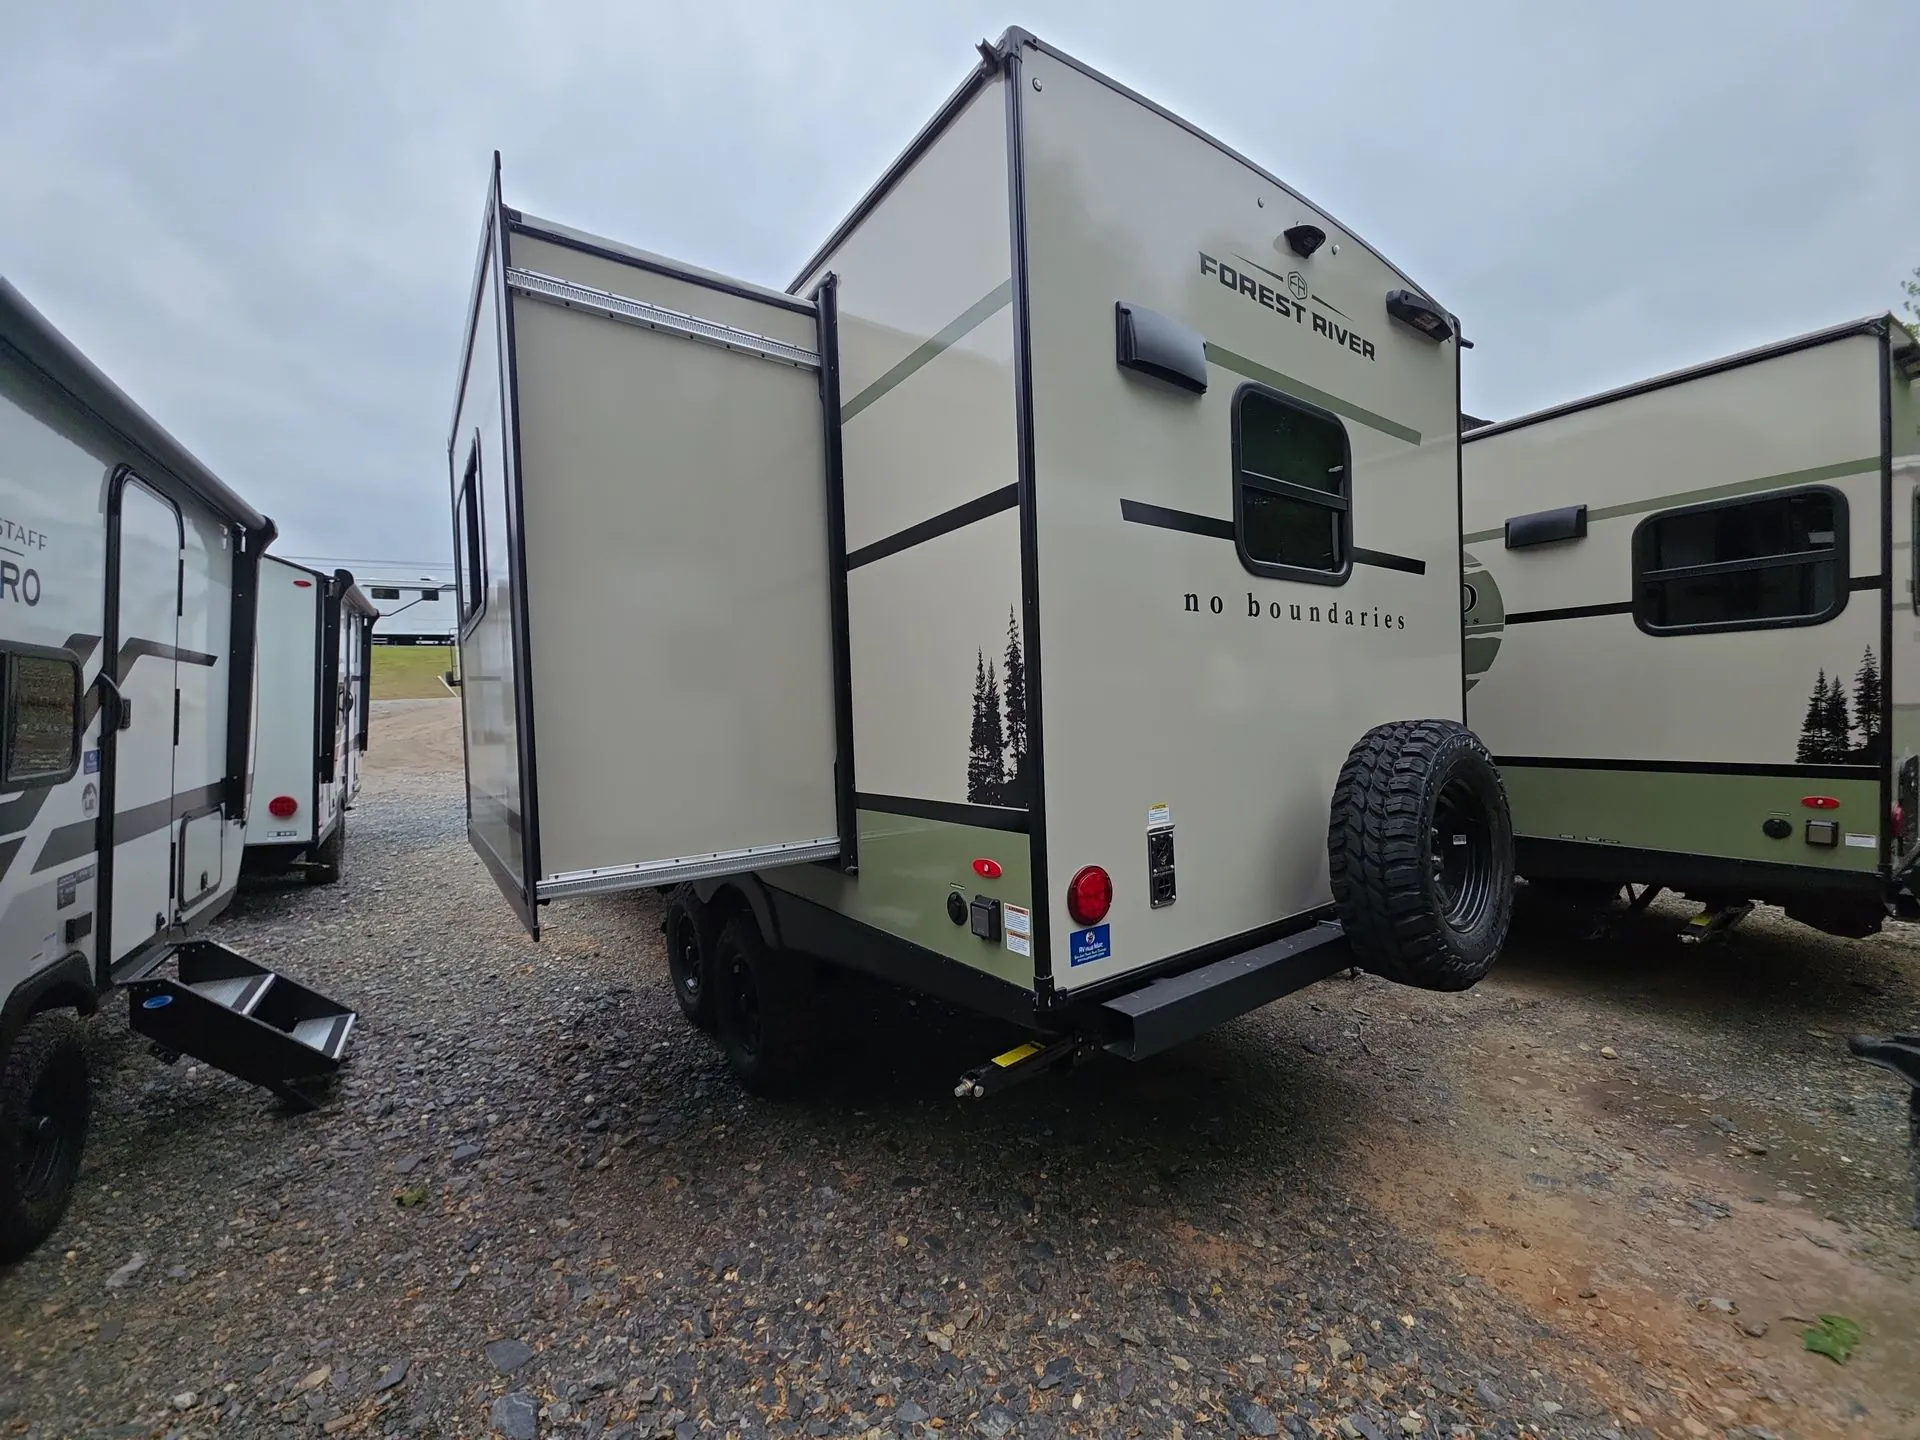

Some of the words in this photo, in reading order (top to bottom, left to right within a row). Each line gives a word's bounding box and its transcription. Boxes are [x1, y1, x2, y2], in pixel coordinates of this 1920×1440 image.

[1199, 251, 1306, 324] FOREST
[1311, 311, 1376, 361] RIVER
[1184, 591, 1224, 614] no
[1247, 592, 1405, 630] boundaries
